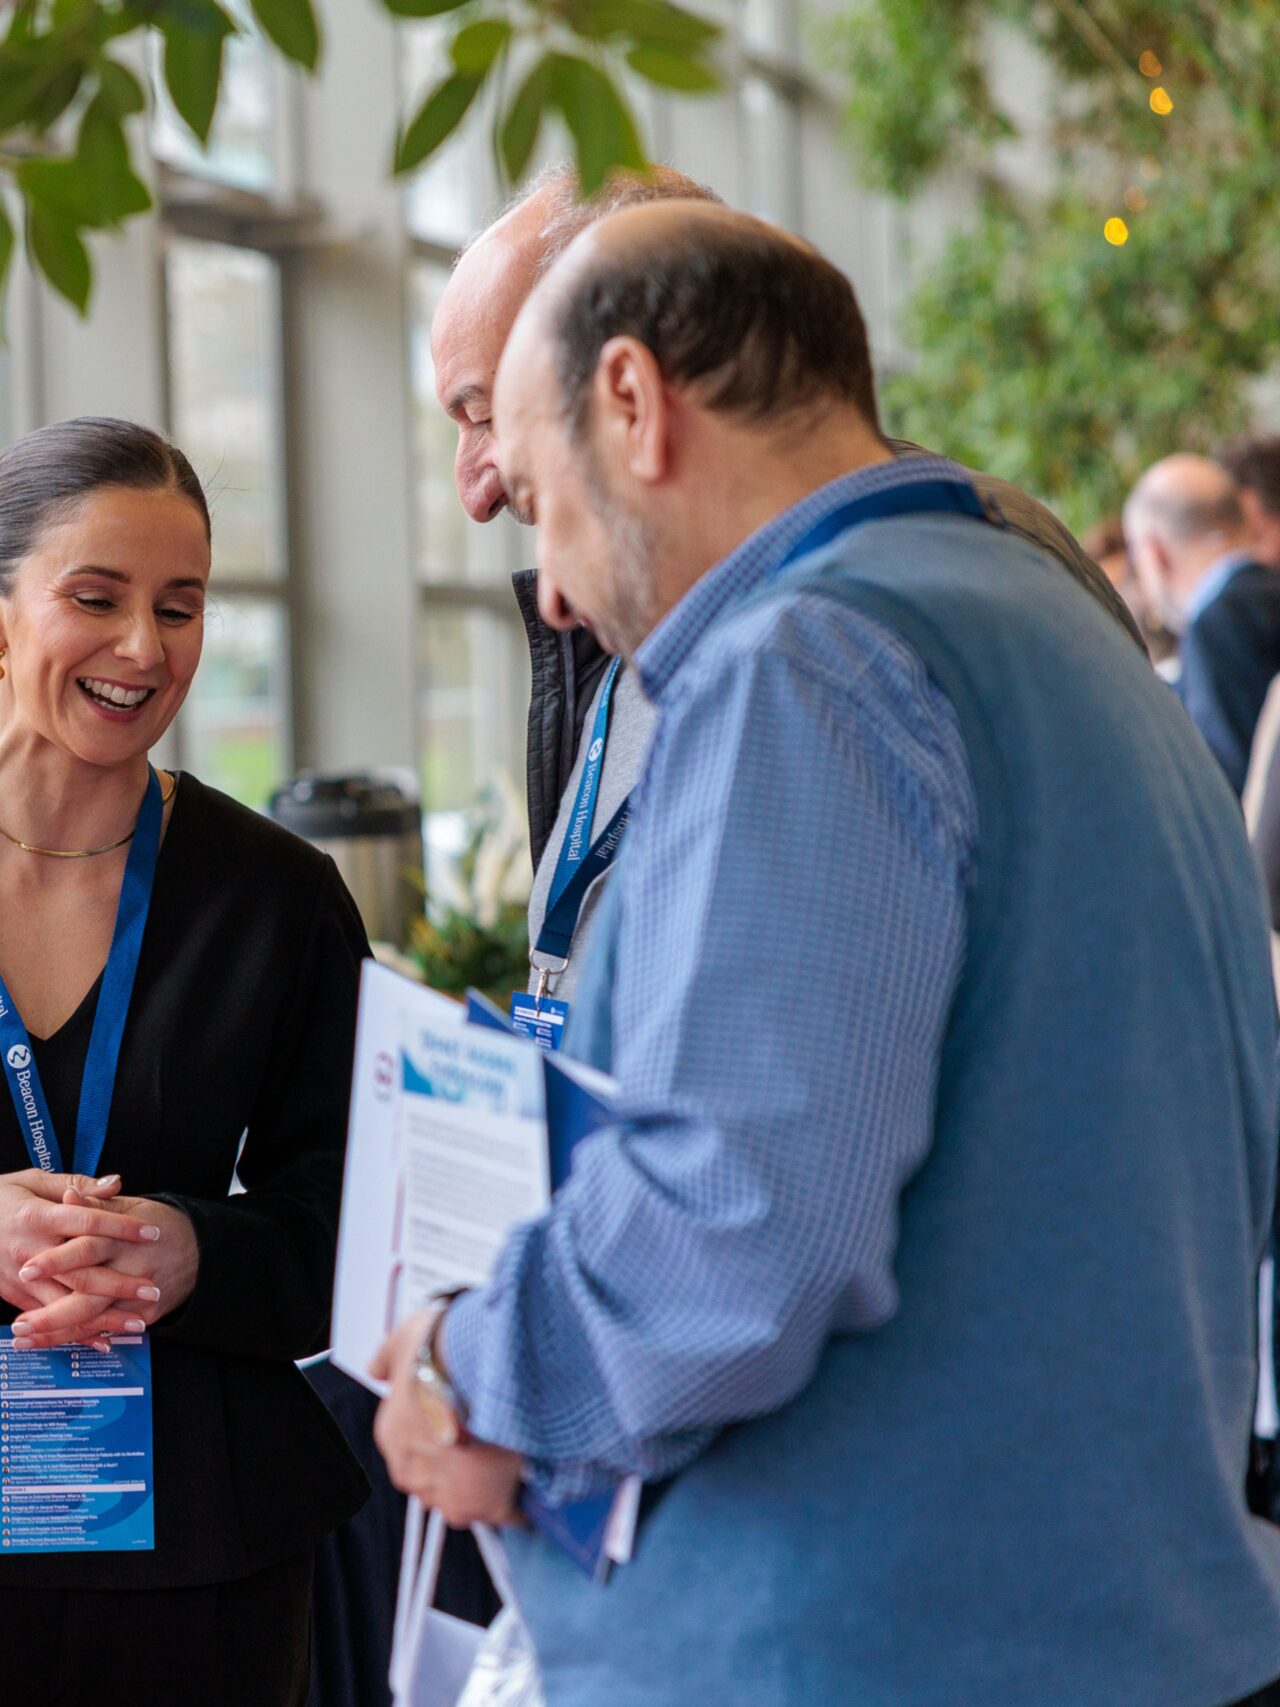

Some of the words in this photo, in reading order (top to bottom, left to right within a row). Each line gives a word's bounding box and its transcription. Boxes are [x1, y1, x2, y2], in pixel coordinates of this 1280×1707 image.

[567, 809, 588, 861] Hospital
[16, 1069, 38, 1119] Beacon
[29, 1119, 56, 1173] Hospital
